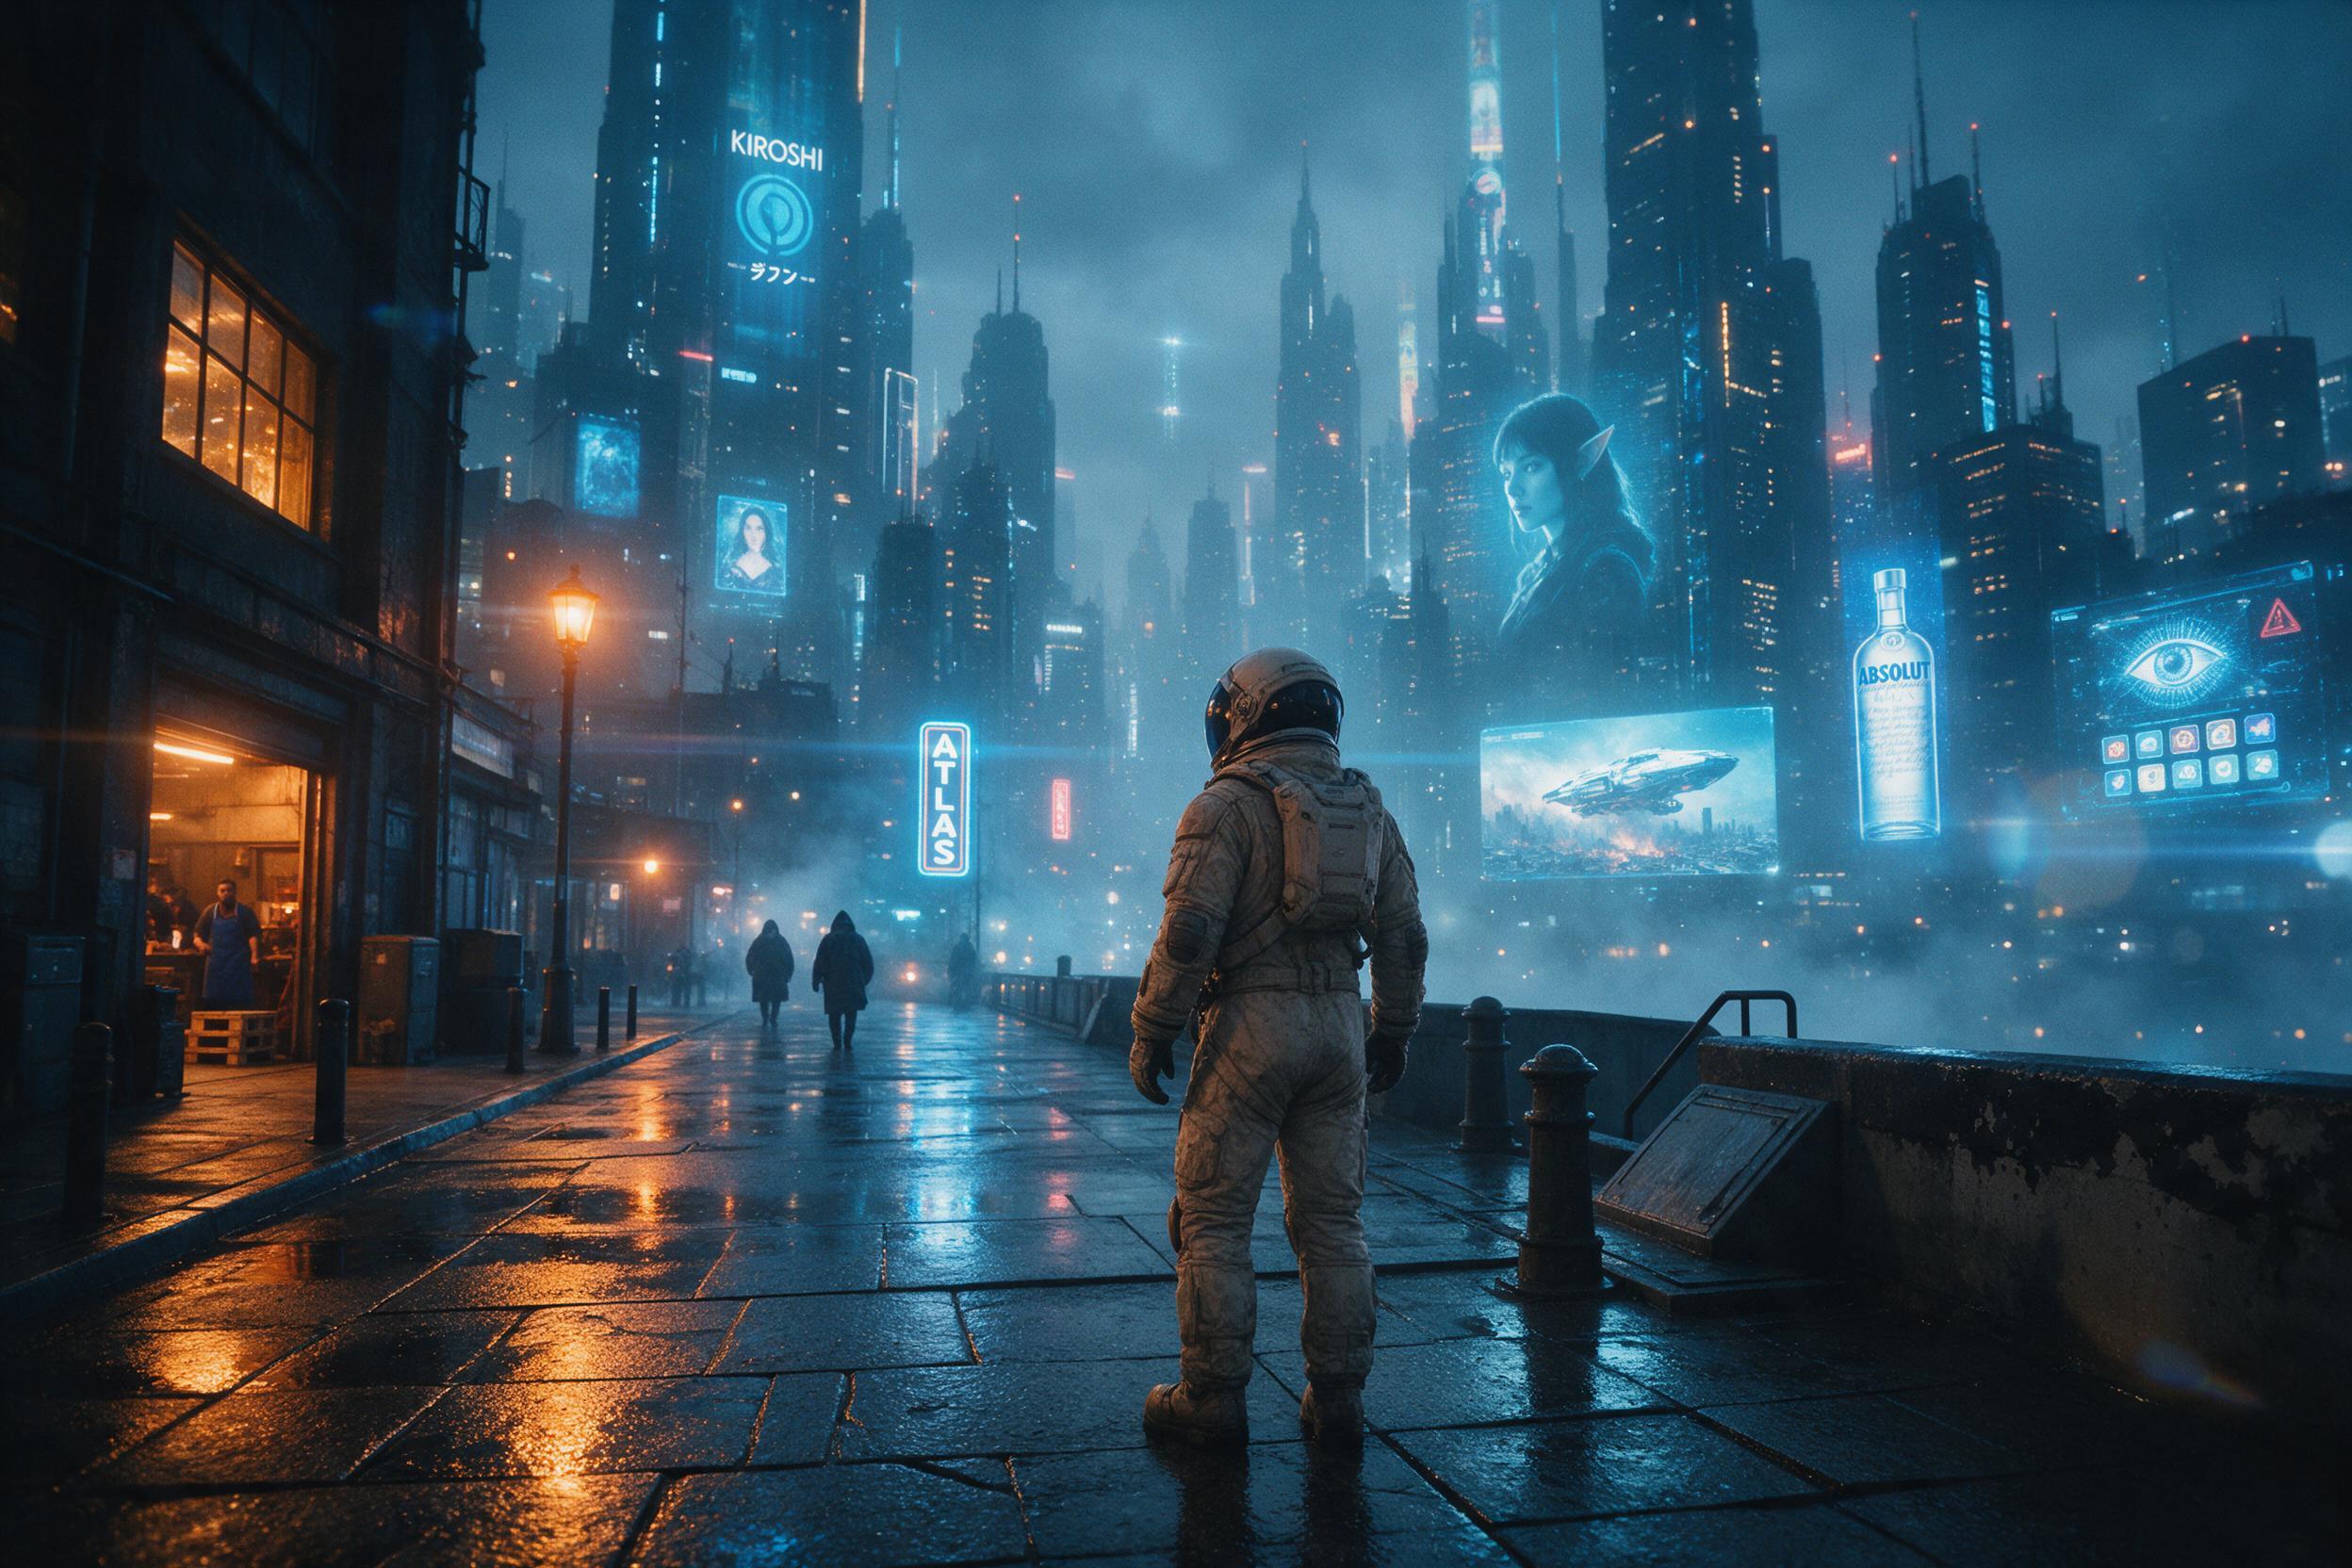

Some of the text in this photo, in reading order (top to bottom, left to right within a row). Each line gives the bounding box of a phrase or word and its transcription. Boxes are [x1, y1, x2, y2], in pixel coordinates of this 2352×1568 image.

[731, 129, 823, 172] KIROSHI
[1859, 661, 1931, 686] ABSOLUT
[931, 732, 958, 865] ATLAS
